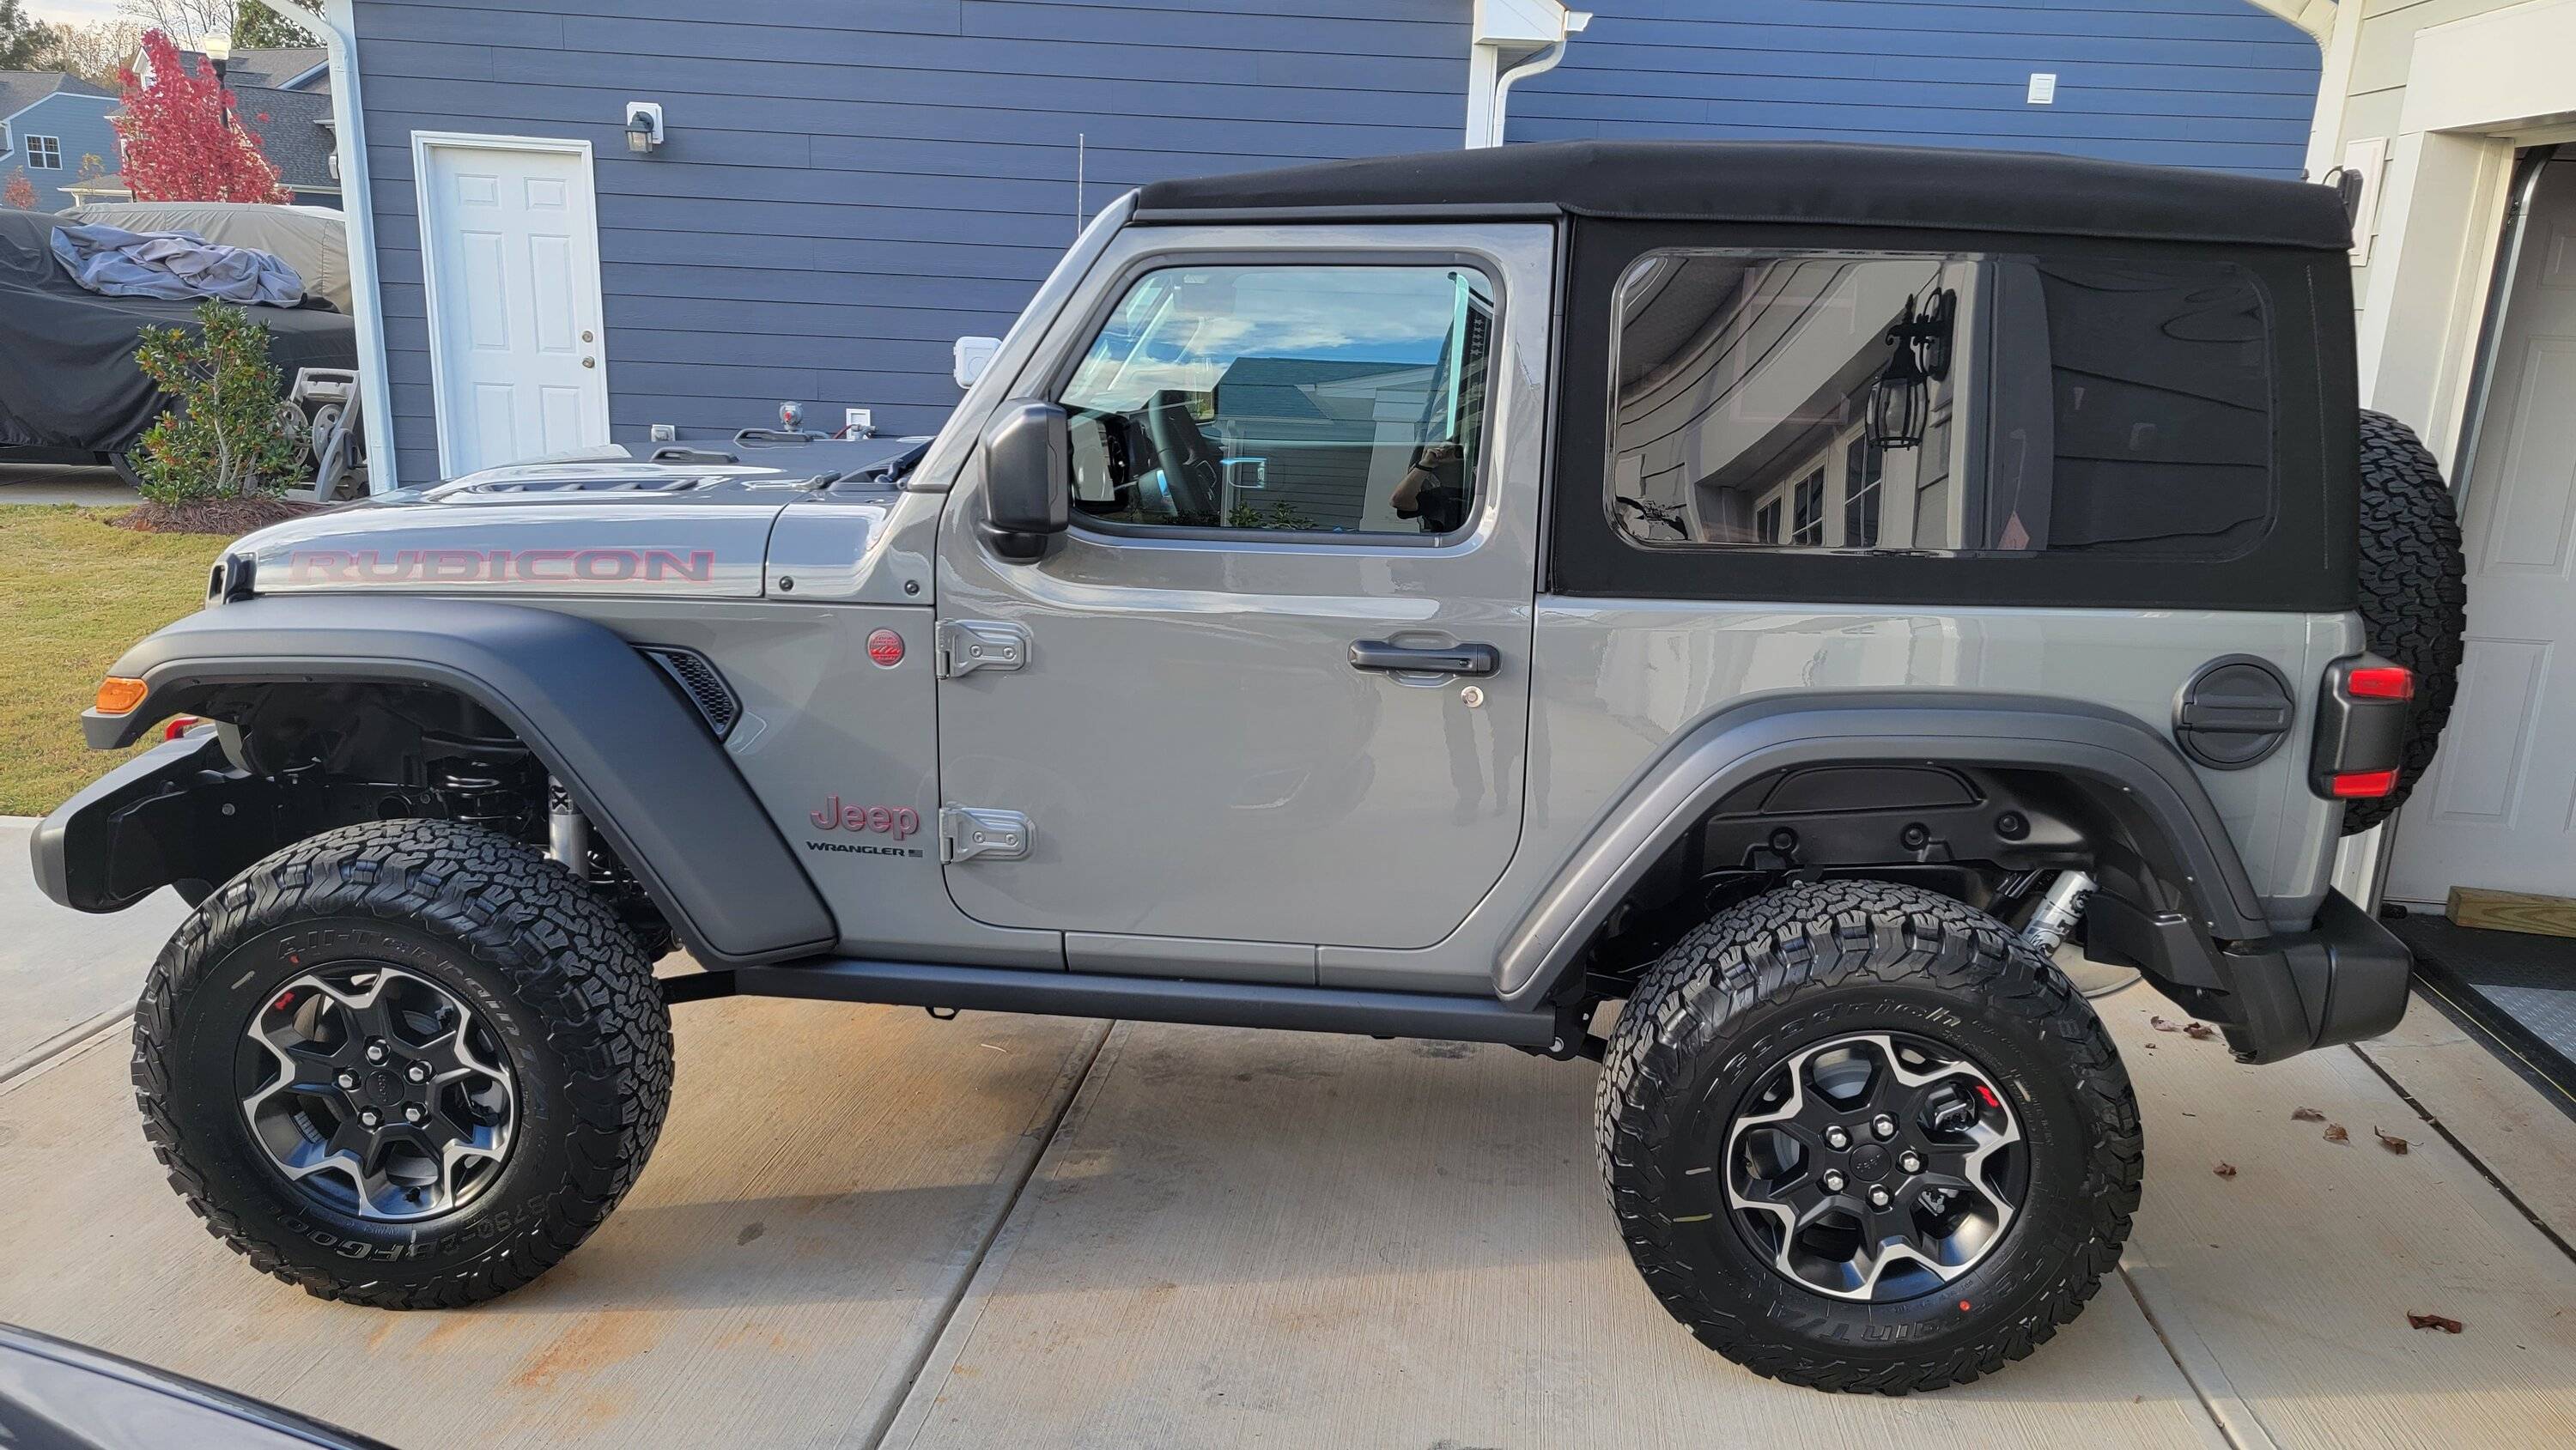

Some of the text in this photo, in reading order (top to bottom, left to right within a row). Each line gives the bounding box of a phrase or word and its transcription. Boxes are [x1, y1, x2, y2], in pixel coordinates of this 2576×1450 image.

[289, 549, 714, 584] RUBICON
[811, 796, 919, 841] Jeep
[806, 840, 905, 857] WRANGLER
